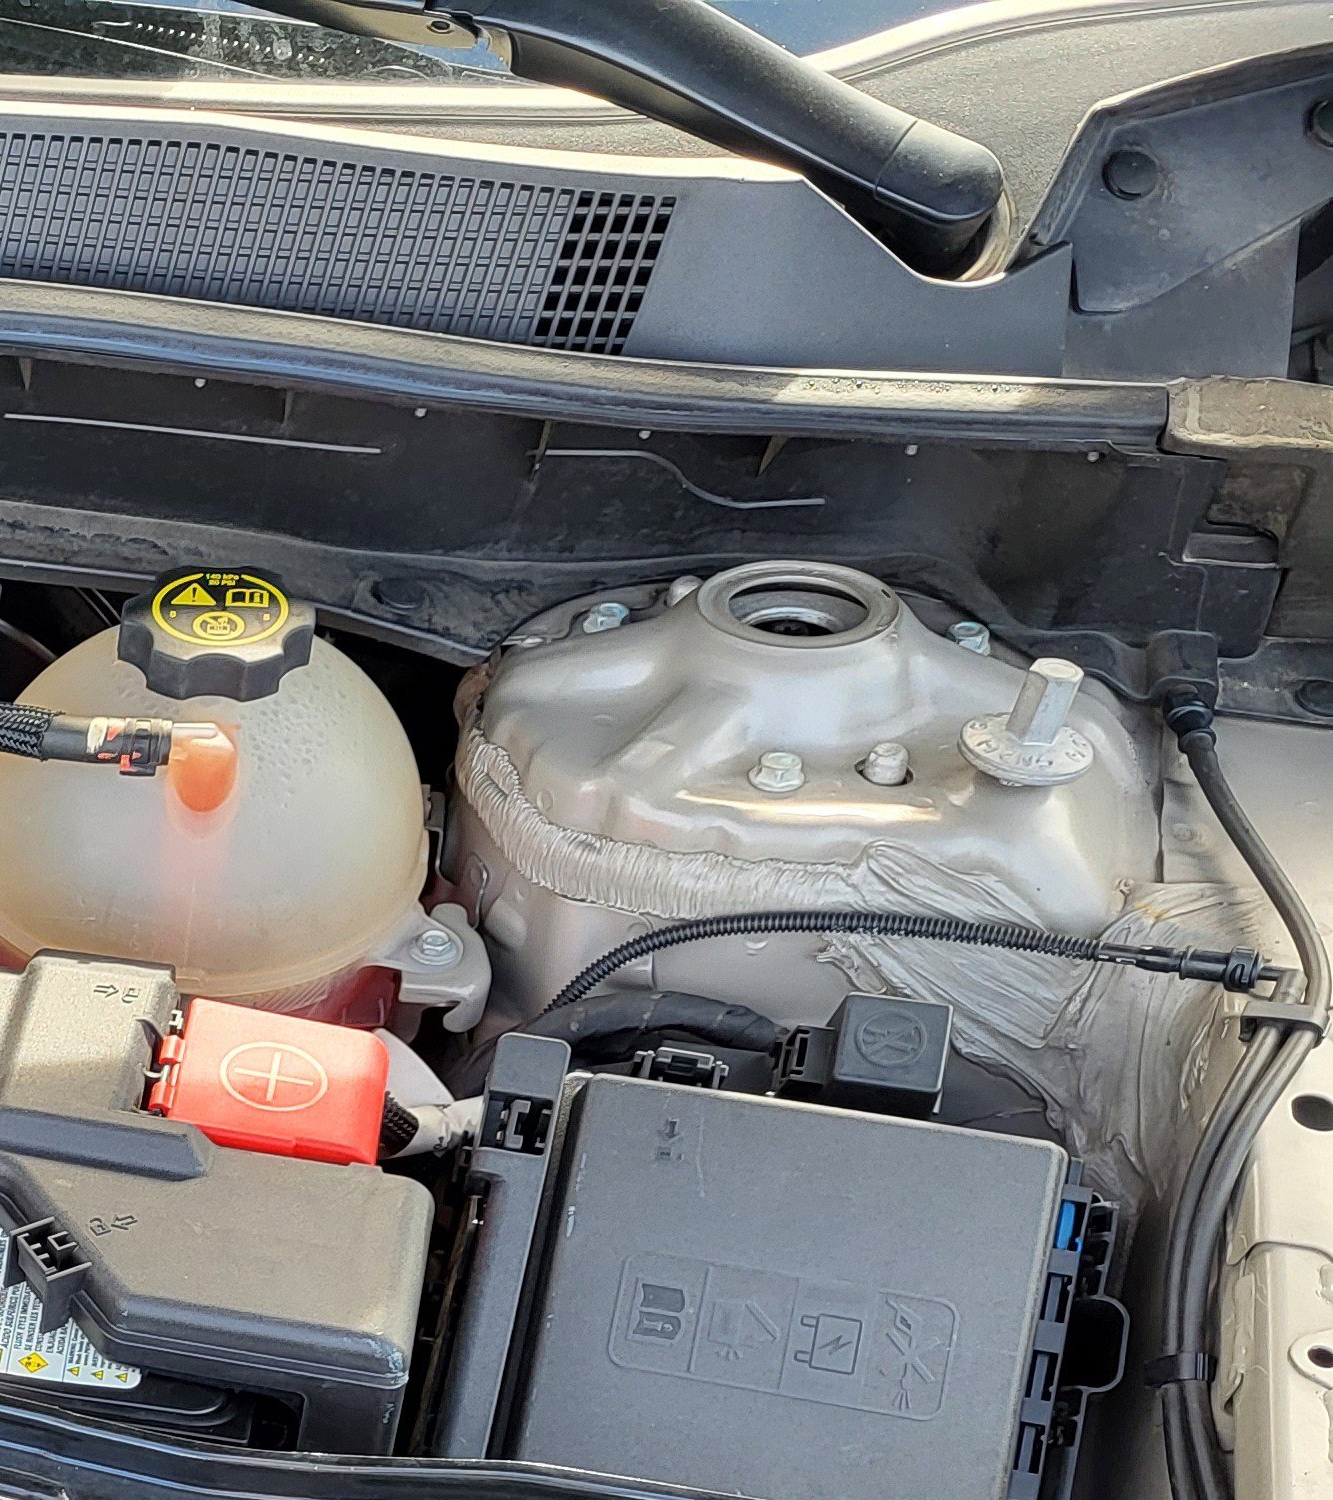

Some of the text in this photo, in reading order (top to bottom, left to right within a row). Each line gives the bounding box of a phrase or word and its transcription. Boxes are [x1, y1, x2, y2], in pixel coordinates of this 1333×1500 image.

[17, 1315, 27, 1329] EYES
[24, 1343, 32, 1351] SE
[30, 1310, 39, 1321] LES
